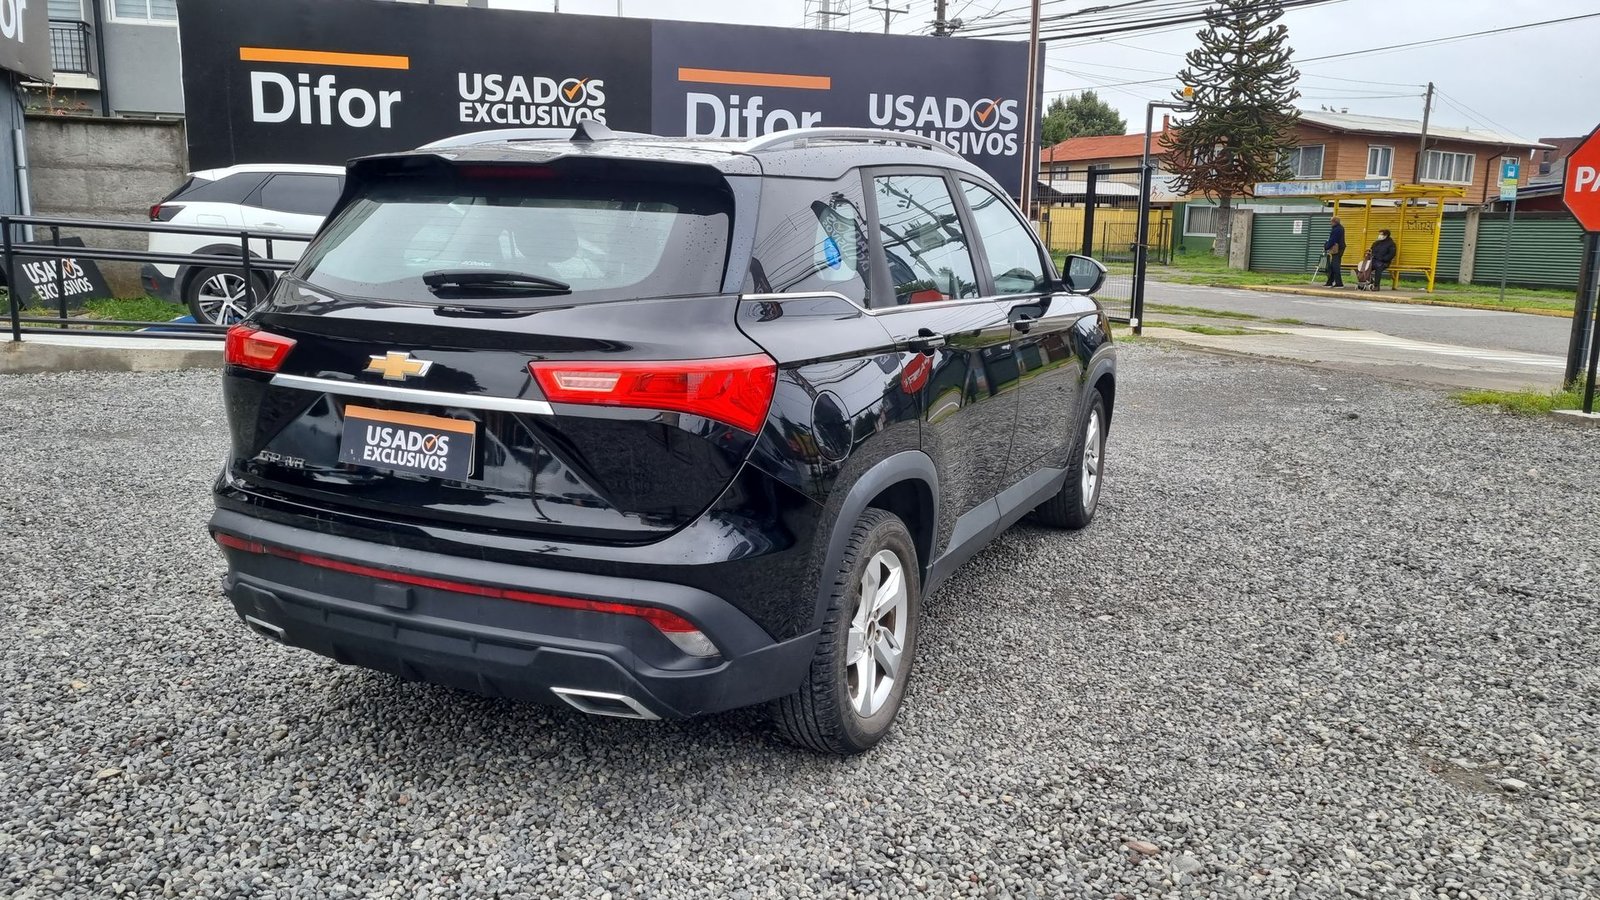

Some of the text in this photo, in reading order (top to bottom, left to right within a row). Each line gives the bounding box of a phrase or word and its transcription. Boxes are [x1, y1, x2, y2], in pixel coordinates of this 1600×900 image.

[250, 71, 402, 128] Difor
[458, 72, 606, 107] USADOS
[459, 101, 607, 127] EXCLUSIVOS
[868, 93, 1019, 131] USADOS
[366, 425, 450, 456] USADOS
[363, 445, 448, 472] EXCLUSIVOS
